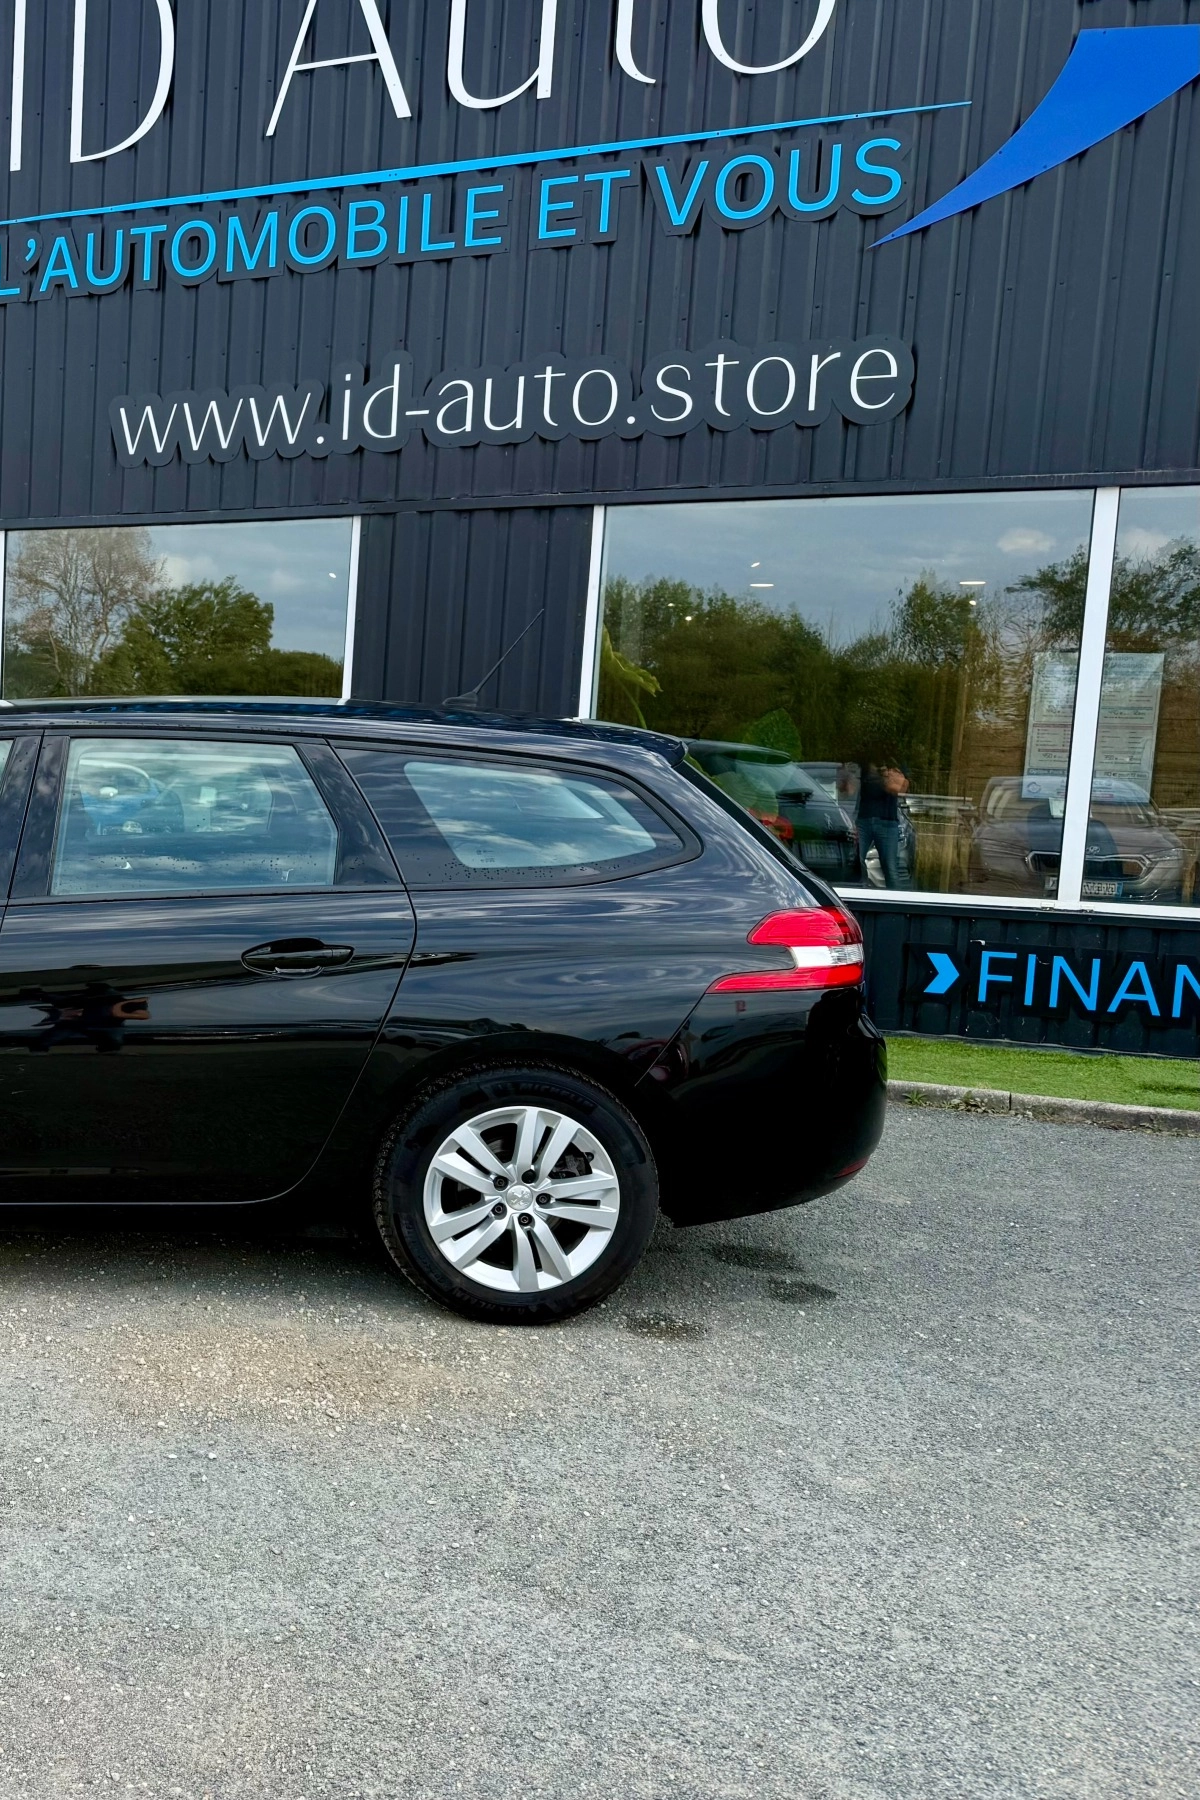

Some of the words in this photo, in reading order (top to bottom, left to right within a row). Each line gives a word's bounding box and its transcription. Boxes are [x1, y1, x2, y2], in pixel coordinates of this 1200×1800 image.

[538, 169, 631, 240] ET
[655, 137, 902, 226] VOUS
[119, 348, 898, 455] www.id-auto.store
